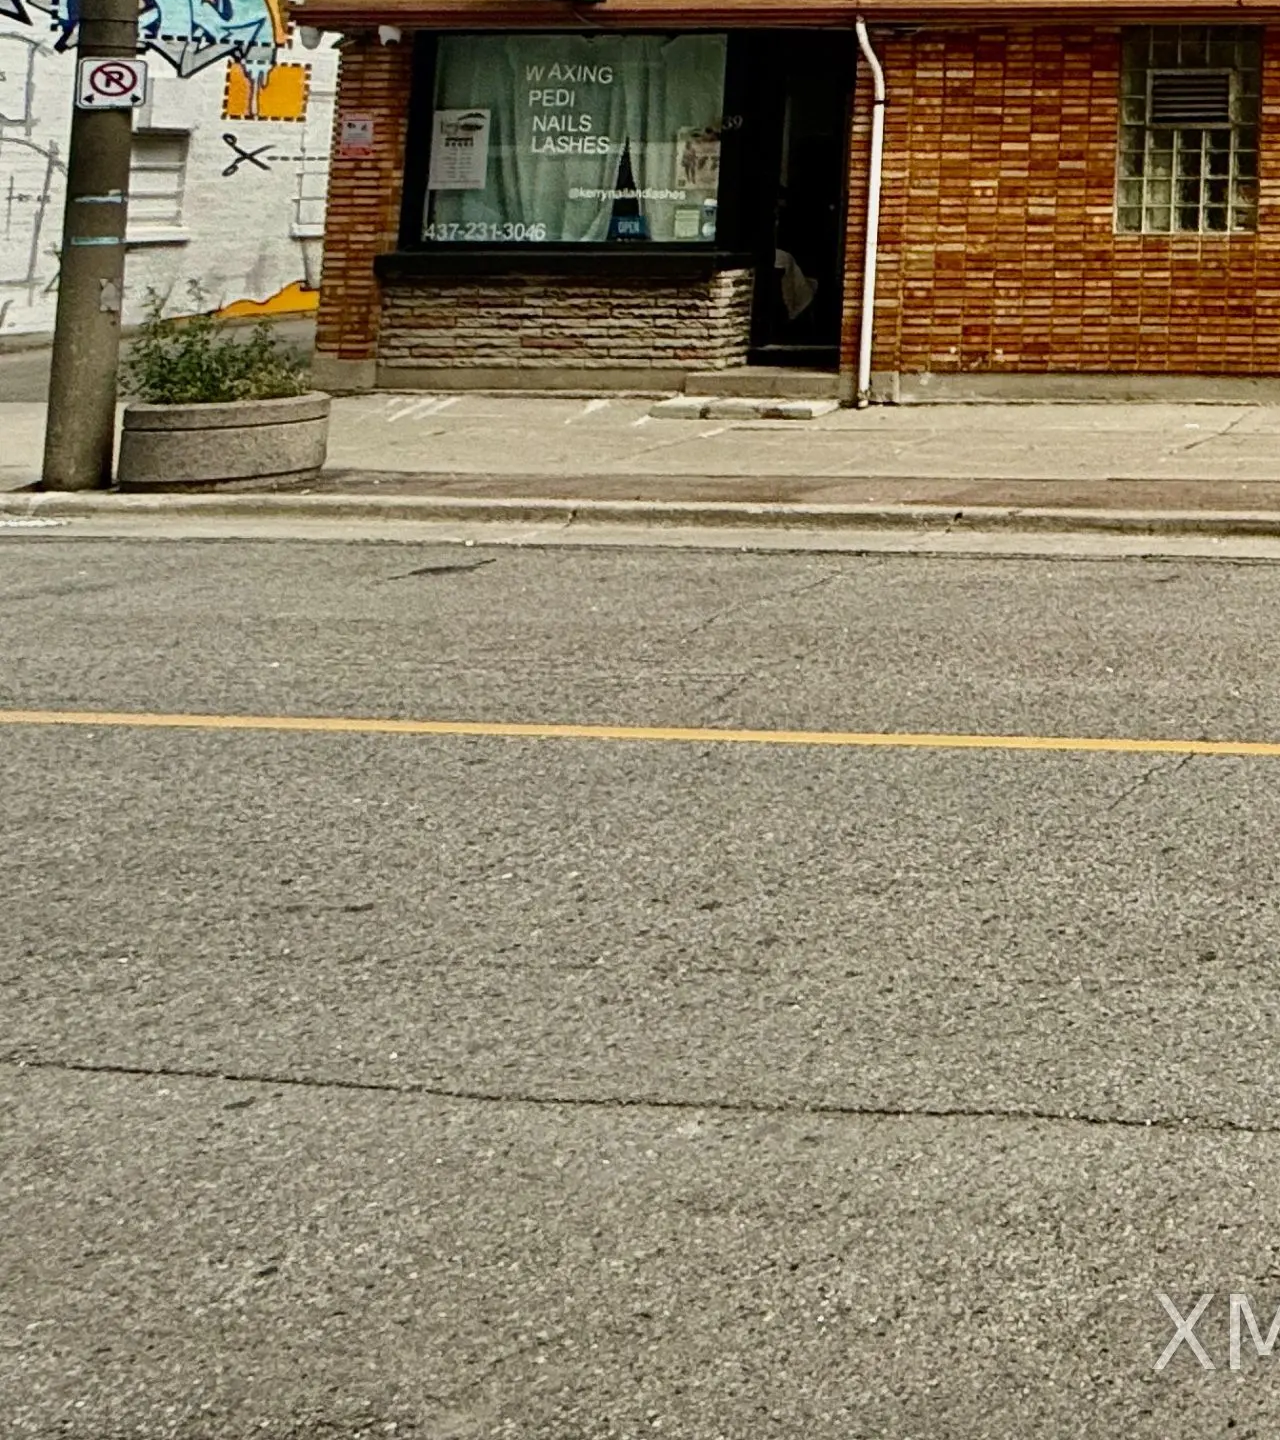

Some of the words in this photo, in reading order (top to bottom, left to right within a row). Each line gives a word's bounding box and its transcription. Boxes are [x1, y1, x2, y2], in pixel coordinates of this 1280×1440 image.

[528, 88, 575, 107] PEDI
[532, 113, 593, 133] NAILS
[531, 135, 611, 155] LASHES
[423, 222, 547, 242] 437-231-3046
